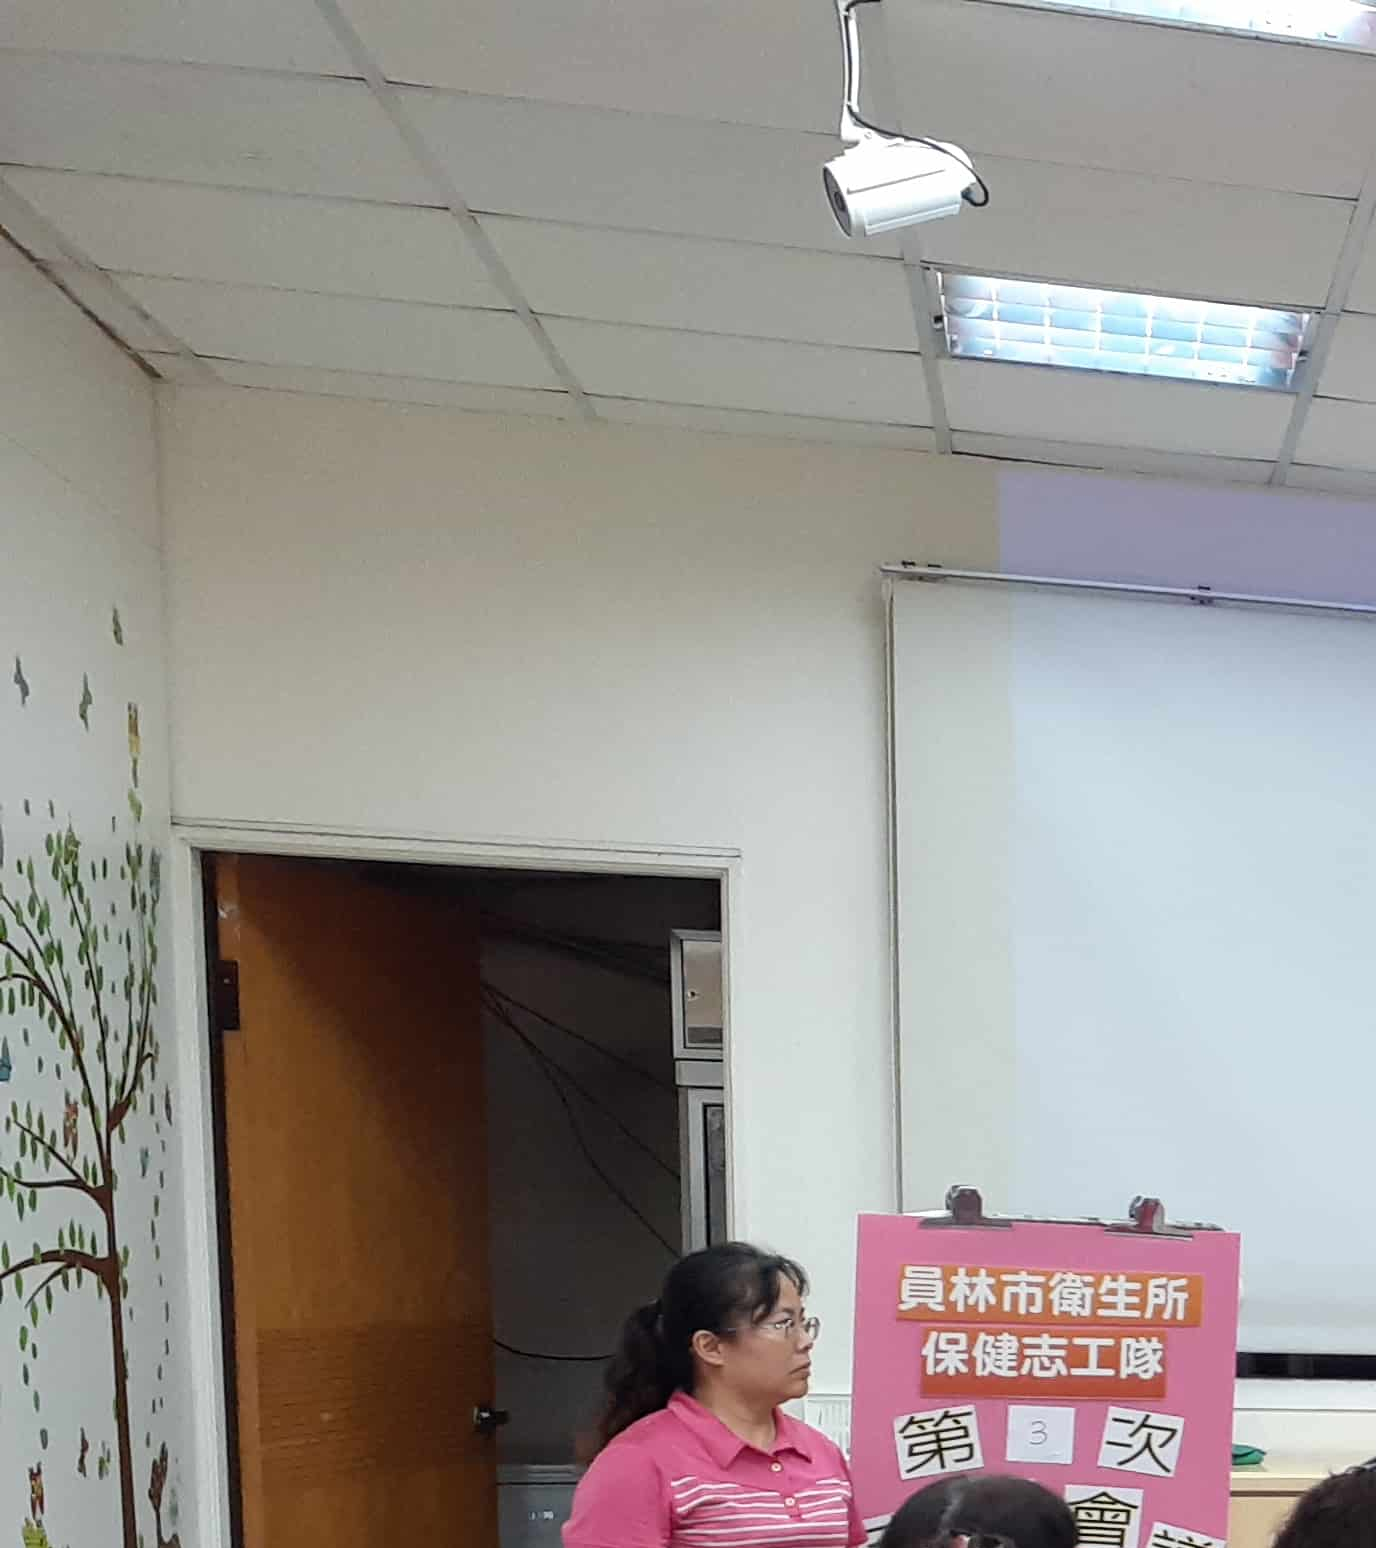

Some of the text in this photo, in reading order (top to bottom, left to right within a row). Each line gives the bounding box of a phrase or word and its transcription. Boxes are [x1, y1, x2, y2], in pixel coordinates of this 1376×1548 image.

[897, 1265, 1189, 1321] 員林市衛生所
[921, 1330, 1165, 1379] 保健志工隊
